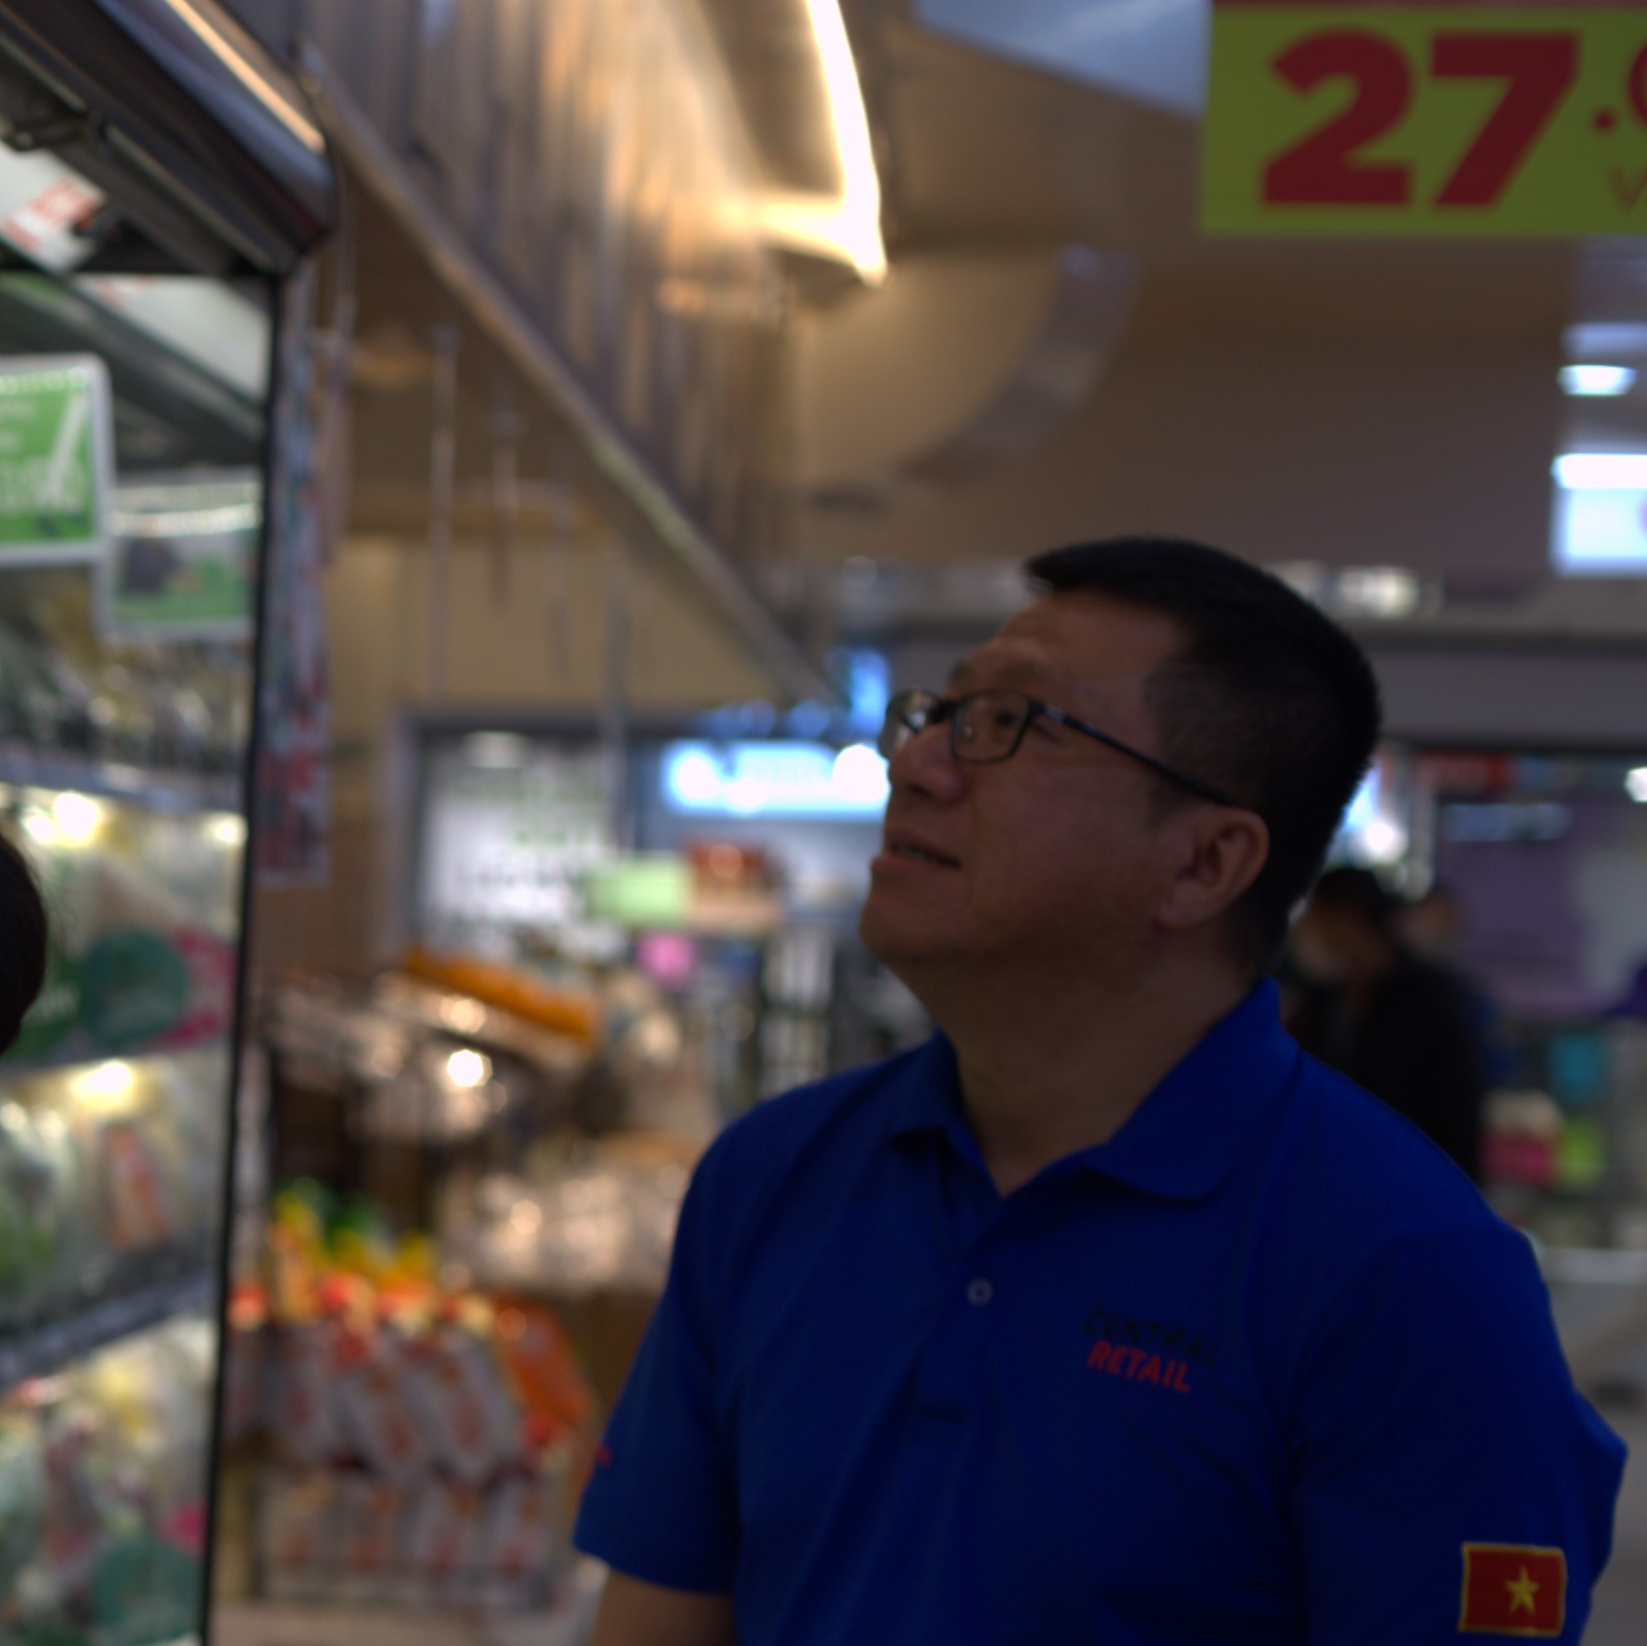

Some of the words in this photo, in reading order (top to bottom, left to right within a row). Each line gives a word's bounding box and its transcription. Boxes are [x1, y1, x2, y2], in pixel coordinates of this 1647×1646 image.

[1262, 22, 1647, 210] 27.
[1083, 1306, 1220, 1370] CENTRAL
[1085, 1339, 1192, 1396] RETAIL
